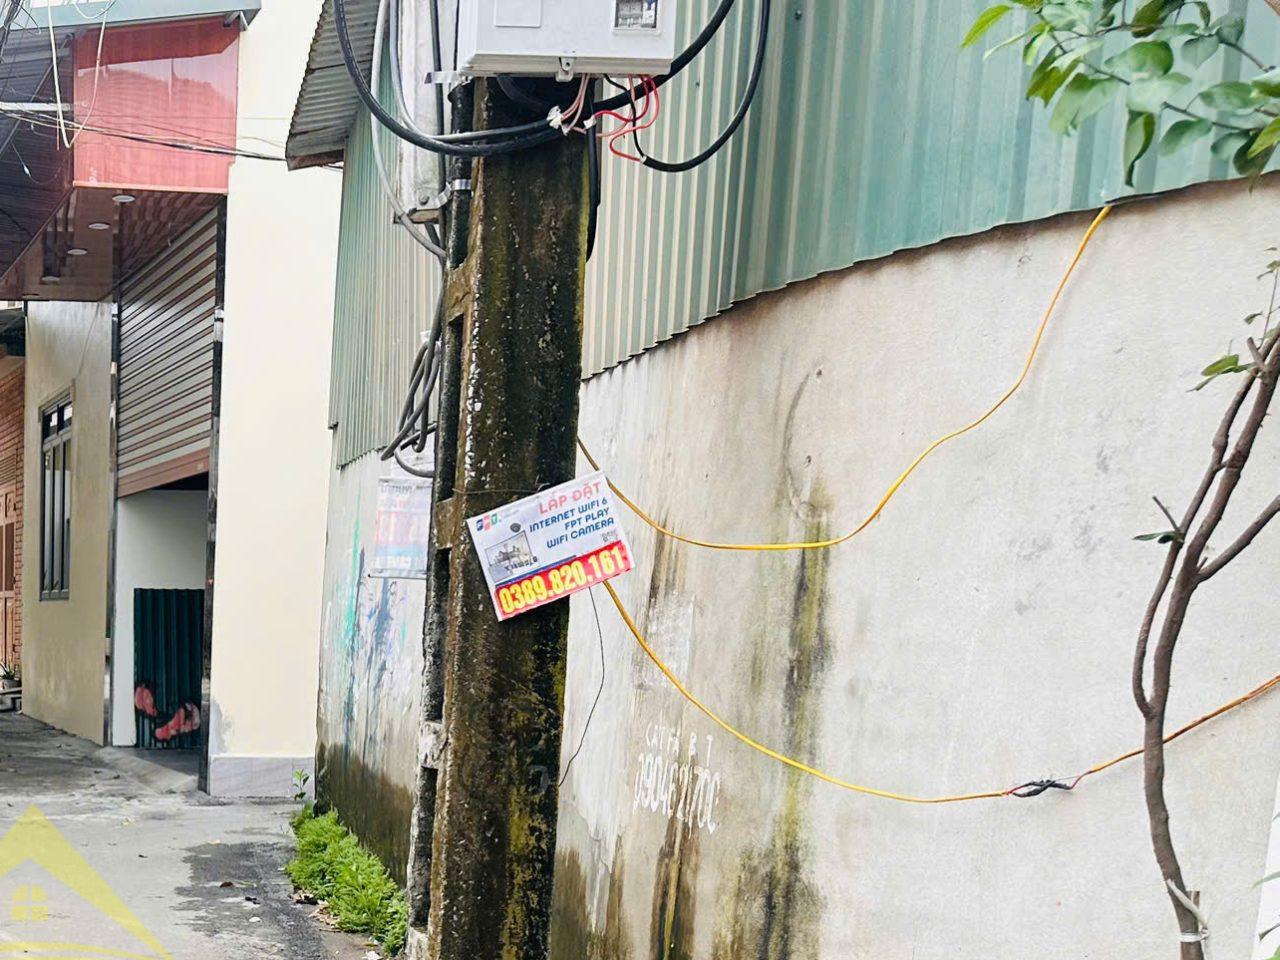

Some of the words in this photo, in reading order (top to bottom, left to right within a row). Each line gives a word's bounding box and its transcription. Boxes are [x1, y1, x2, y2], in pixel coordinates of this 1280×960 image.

[530, 508, 575, 532] INTERNET
[578, 501, 600, 514] WIFI
[602, 498, 608, 507] 6
[565, 517, 584, 530] FPT
[586, 507, 610, 523] PLAY
[547, 534, 569, 549] WIFI
[571, 517, 615, 539] CAMERA
[499, 547, 626, 613] 0389.820.161
